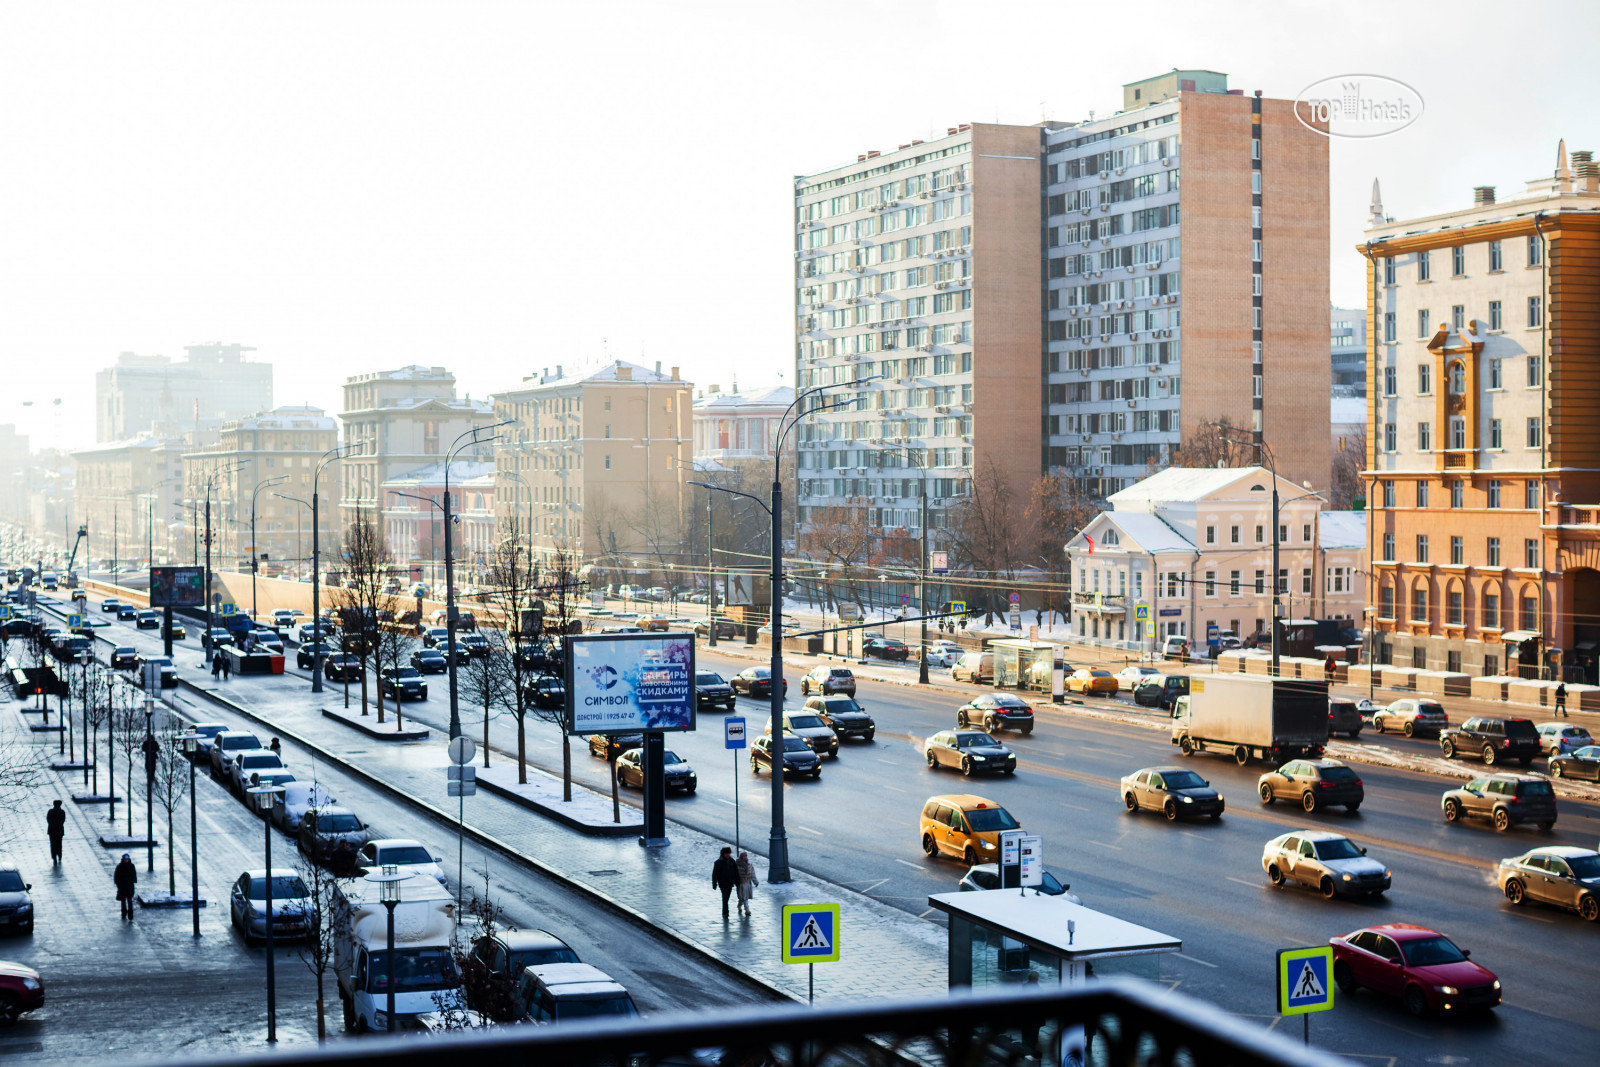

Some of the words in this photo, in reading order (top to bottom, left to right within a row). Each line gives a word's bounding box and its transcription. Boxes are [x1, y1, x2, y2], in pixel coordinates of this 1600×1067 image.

[636, 671, 688, 680] КВАРТИРЫ
[636, 688, 688, 696] СКИДКАМИ
[585, 696, 628, 706] СИМВОЛ
